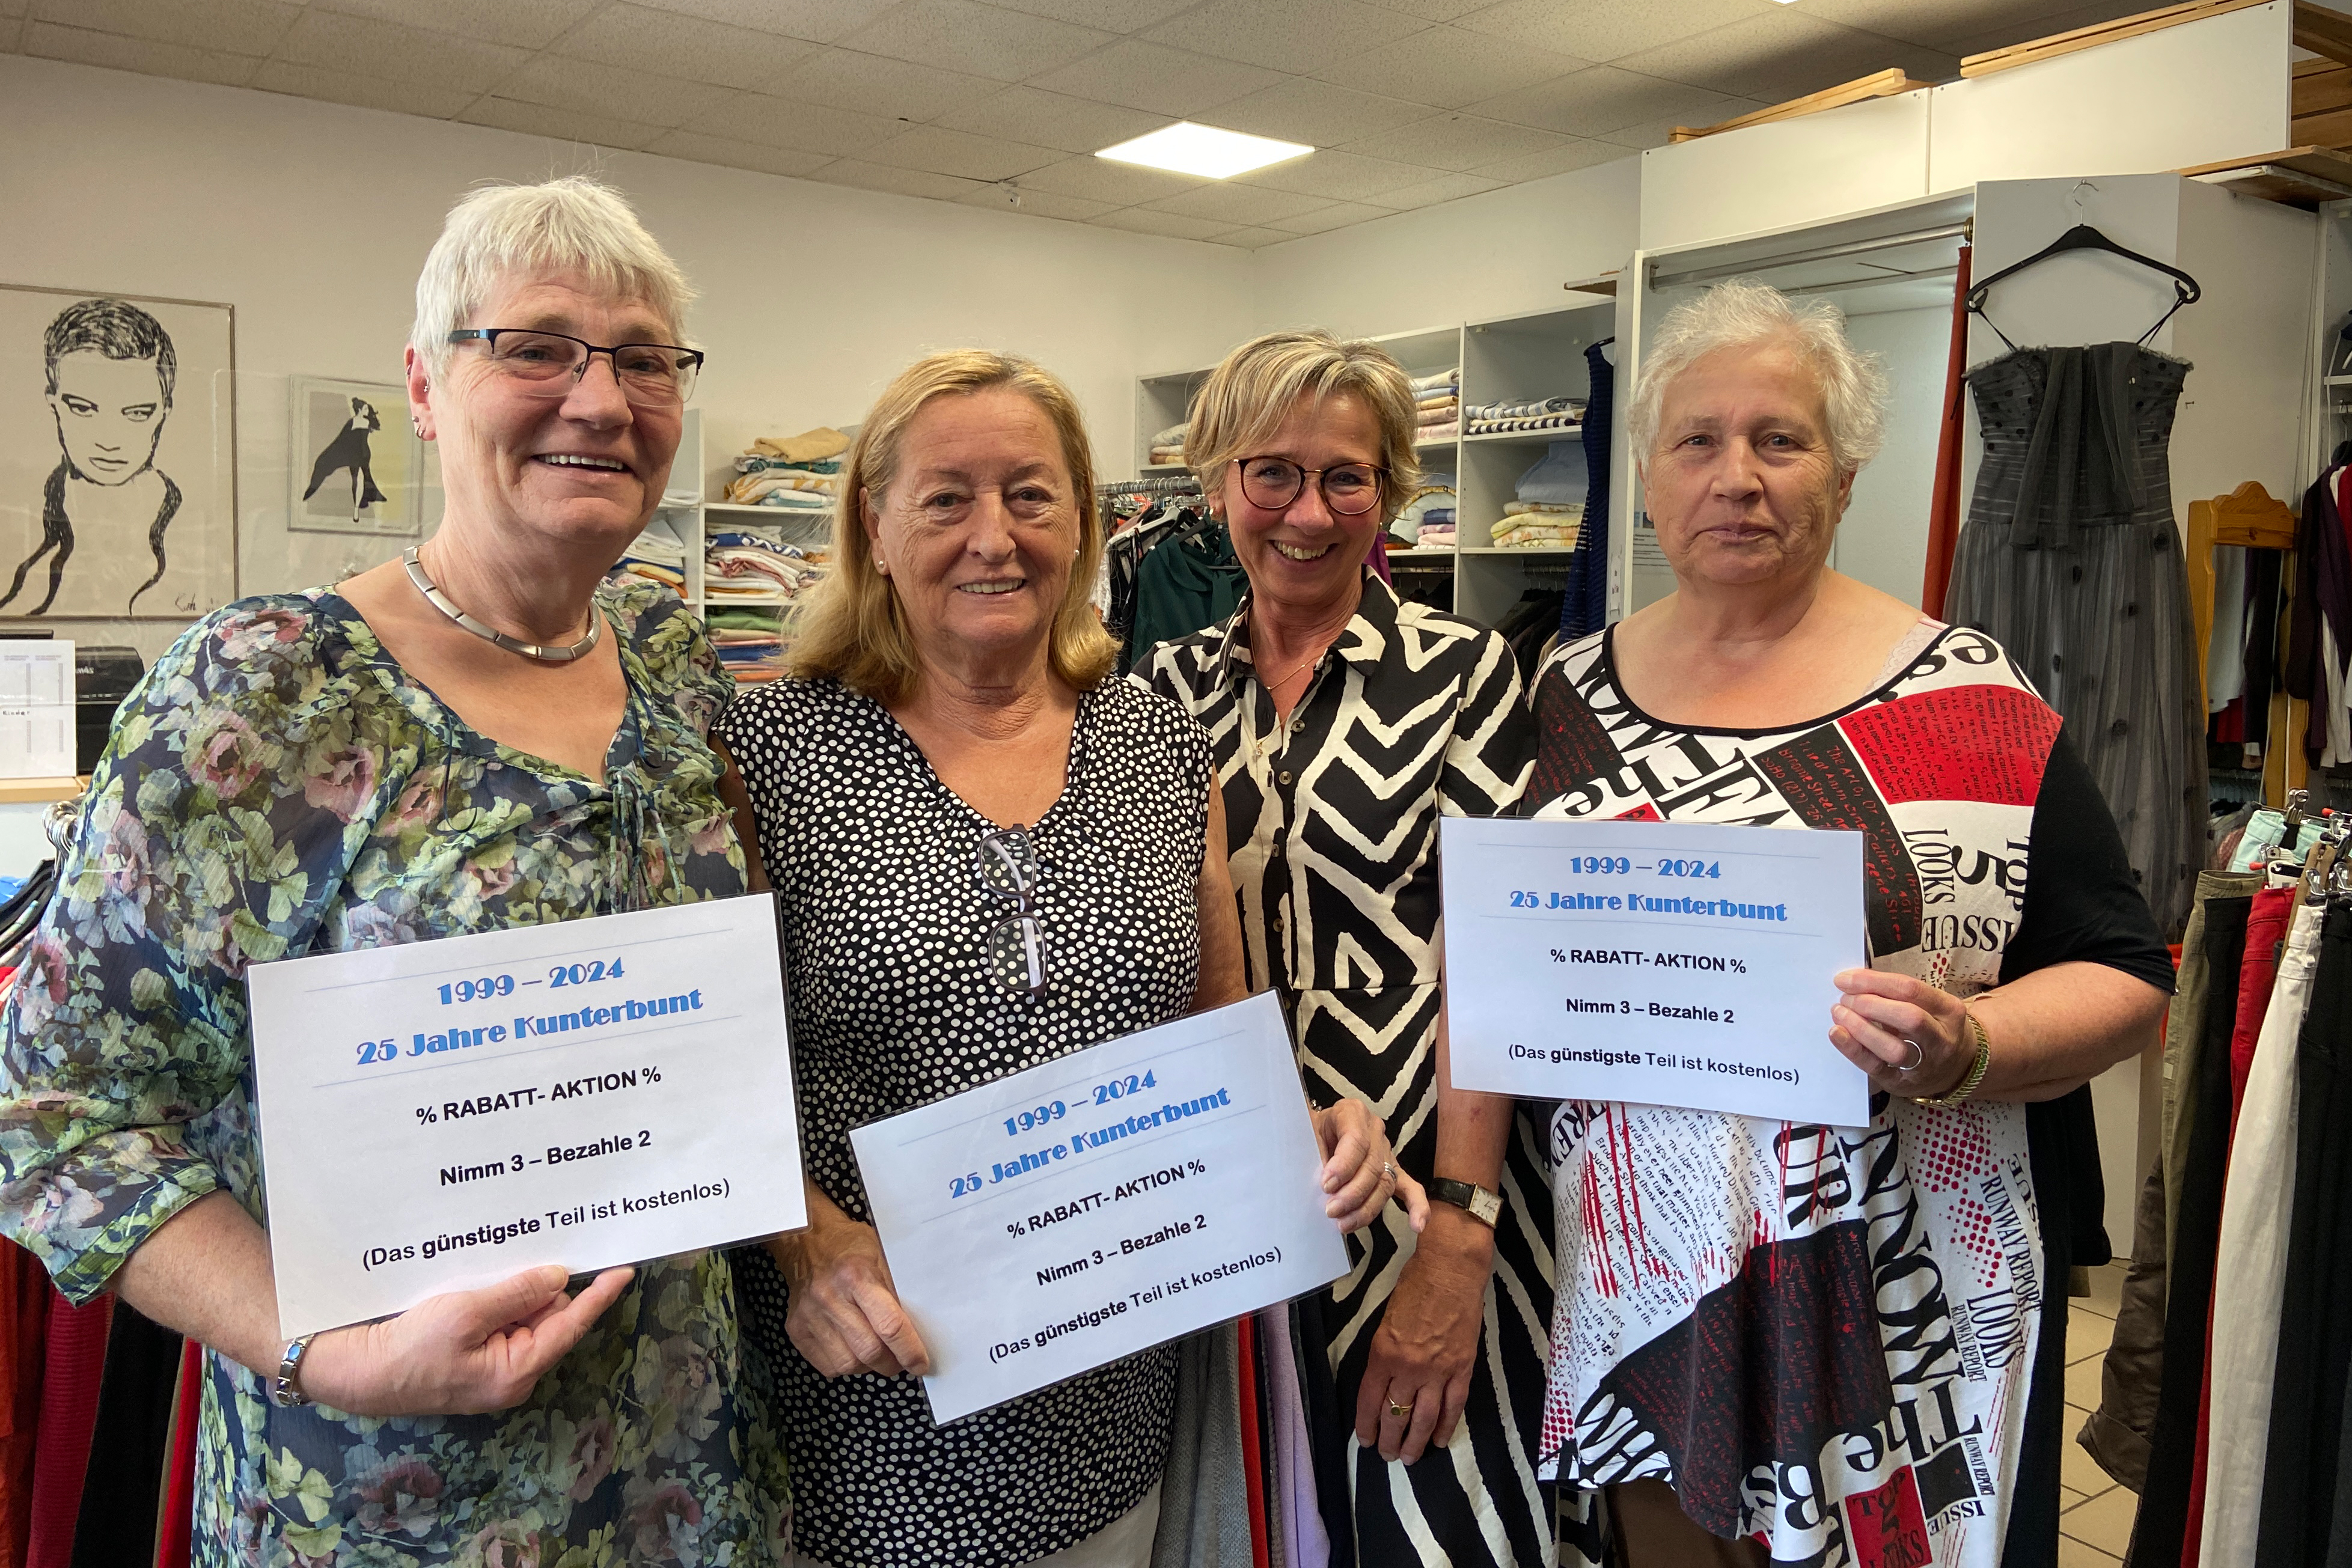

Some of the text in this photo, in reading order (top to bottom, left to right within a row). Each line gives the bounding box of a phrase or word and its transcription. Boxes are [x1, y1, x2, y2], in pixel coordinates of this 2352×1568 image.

[1569, 856, 1631, 875] 1999
[1657, 858, 1722, 879] 2024
[1901, 829, 1956, 904] LOOKS
[1509, 889, 1788, 923] 25 Jahre Kunterbunt
[436, 974, 516, 1006] 1999
[548, 956, 626, 989] 2024
[1550, 948, 1567, 963] %
[1654, 952, 1726, 972] AKTION
[1729, 958, 1747, 974] %
[356, 988, 704, 1066] 25 Jahre Kunterbunt
[1565, 998, 1616, 1014] Nimm
[1619, 999, 1631, 1015] 3
[1648, 1001, 1719, 1022] Bezahle
[1723, 1008, 1735, 1024] 2
[415, 1105, 438, 1126] %
[550, 1069, 637, 1102] AKTION
[641, 1065, 662, 1085] %
[1508, 1043, 1800, 1087] (Das günstigste Teil ist kostenlos)
[1002, 1100, 1067, 1137] 1999
[1092, 1068, 1158, 1106] 2024
[439, 1161, 506, 1187] Nimm
[510, 1153, 525, 1173] 3
[546, 1134, 634, 1166] Bezahle
[637, 1129, 652, 1148] 2
[948, 1087, 1232, 1200] 25 Jahre Kunterbunt
[362, 1177, 730, 1272] (Das günstigste Teil ist kostenlos)
[1006, 1221, 1026, 1240] %
[1114, 1164, 1186, 1202] AKTION
[1187, 1158, 1206, 1177] %
[1036, 1258, 1090, 1287] Nimm
[1091, 1249, 1105, 1266] 3
[1119, 1221, 1192, 1255] Bezahle
[1193, 1213, 1208, 1230] 2
[1980, 1174, 2029, 1250] RUNWAY
[2006, 1247, 2043, 1314] REPORT
[989, 1245, 1282, 1365] (Das günstigste Teil ist kostenlos)
[1967, 1287, 2027, 1370] LOOKS
[1951, 1303, 1988, 1384] RUNWAY REPORT
[1842, 1376, 1983, 1472] The
[1927, 1499, 1987, 1537] ISSUE
